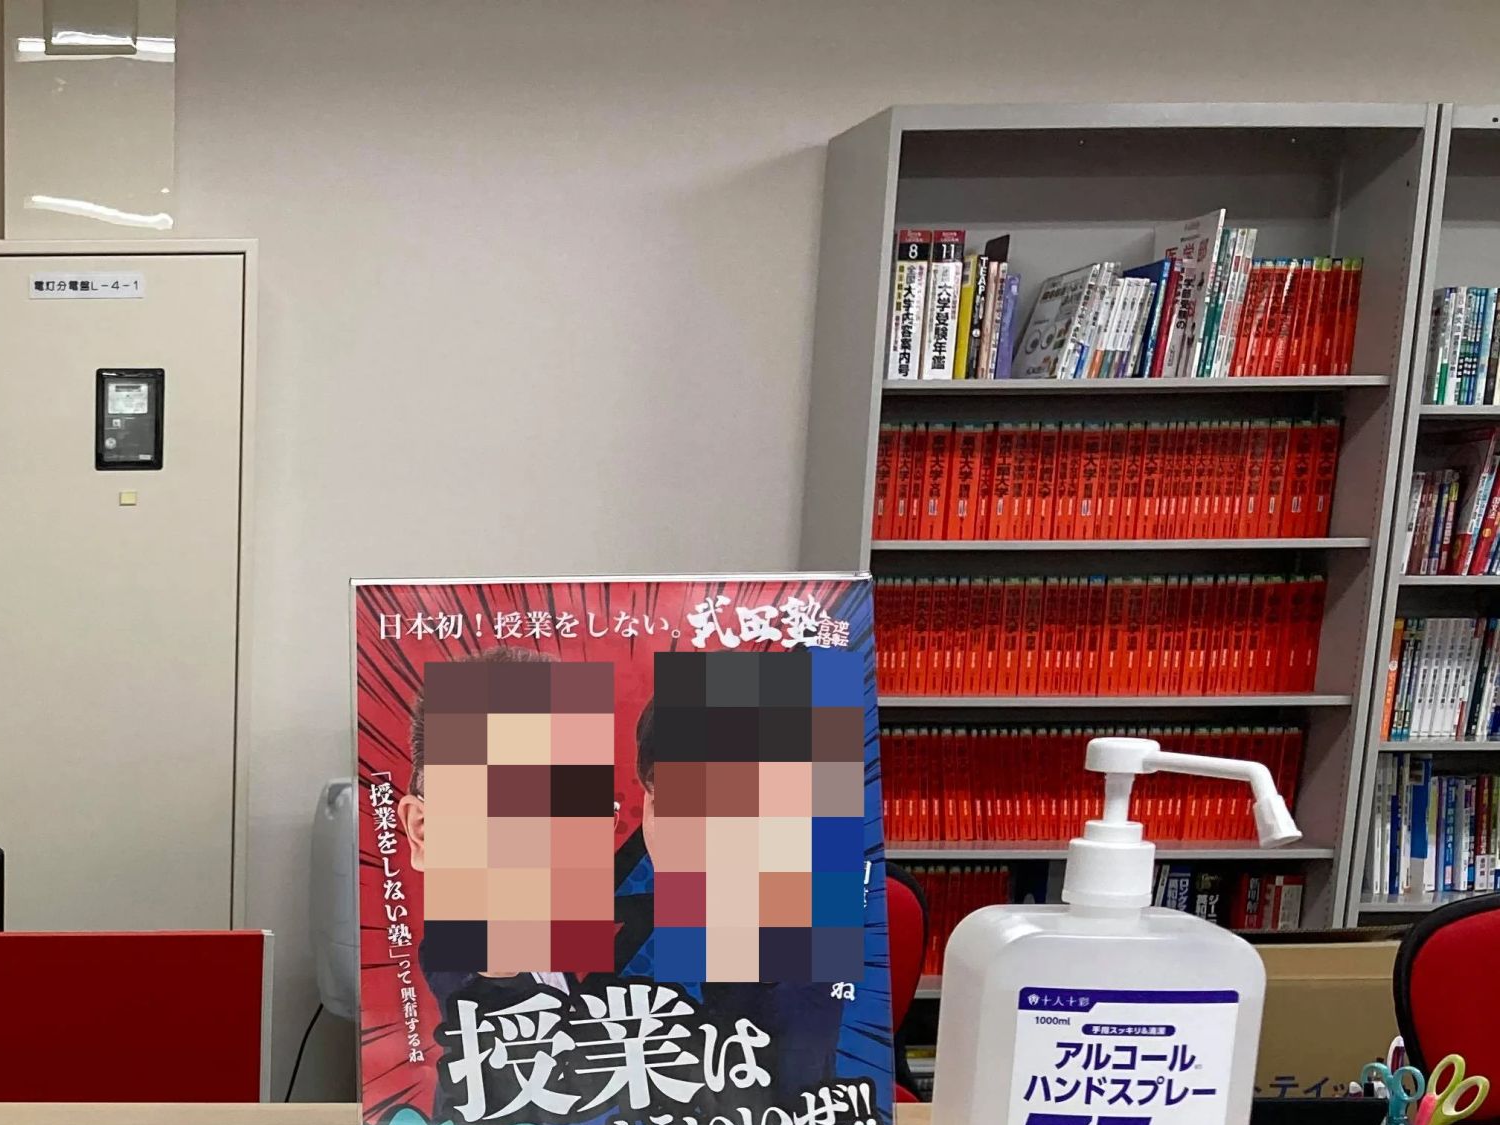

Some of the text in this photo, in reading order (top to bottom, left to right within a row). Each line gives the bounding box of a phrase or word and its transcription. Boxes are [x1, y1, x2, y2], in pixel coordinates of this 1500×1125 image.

[908, 243, 919, 260] 8
[941, 243, 956, 260] 11
[977, 256, 989, 294] TEAP
[1034, 1015, 1071, 1027] 1000ml
[445, 981, 772, 1123] 授業は
[1054, 1042, 1197, 1072] アルコール
[1023, 1075, 1217, 1106] ハンドスプレー
